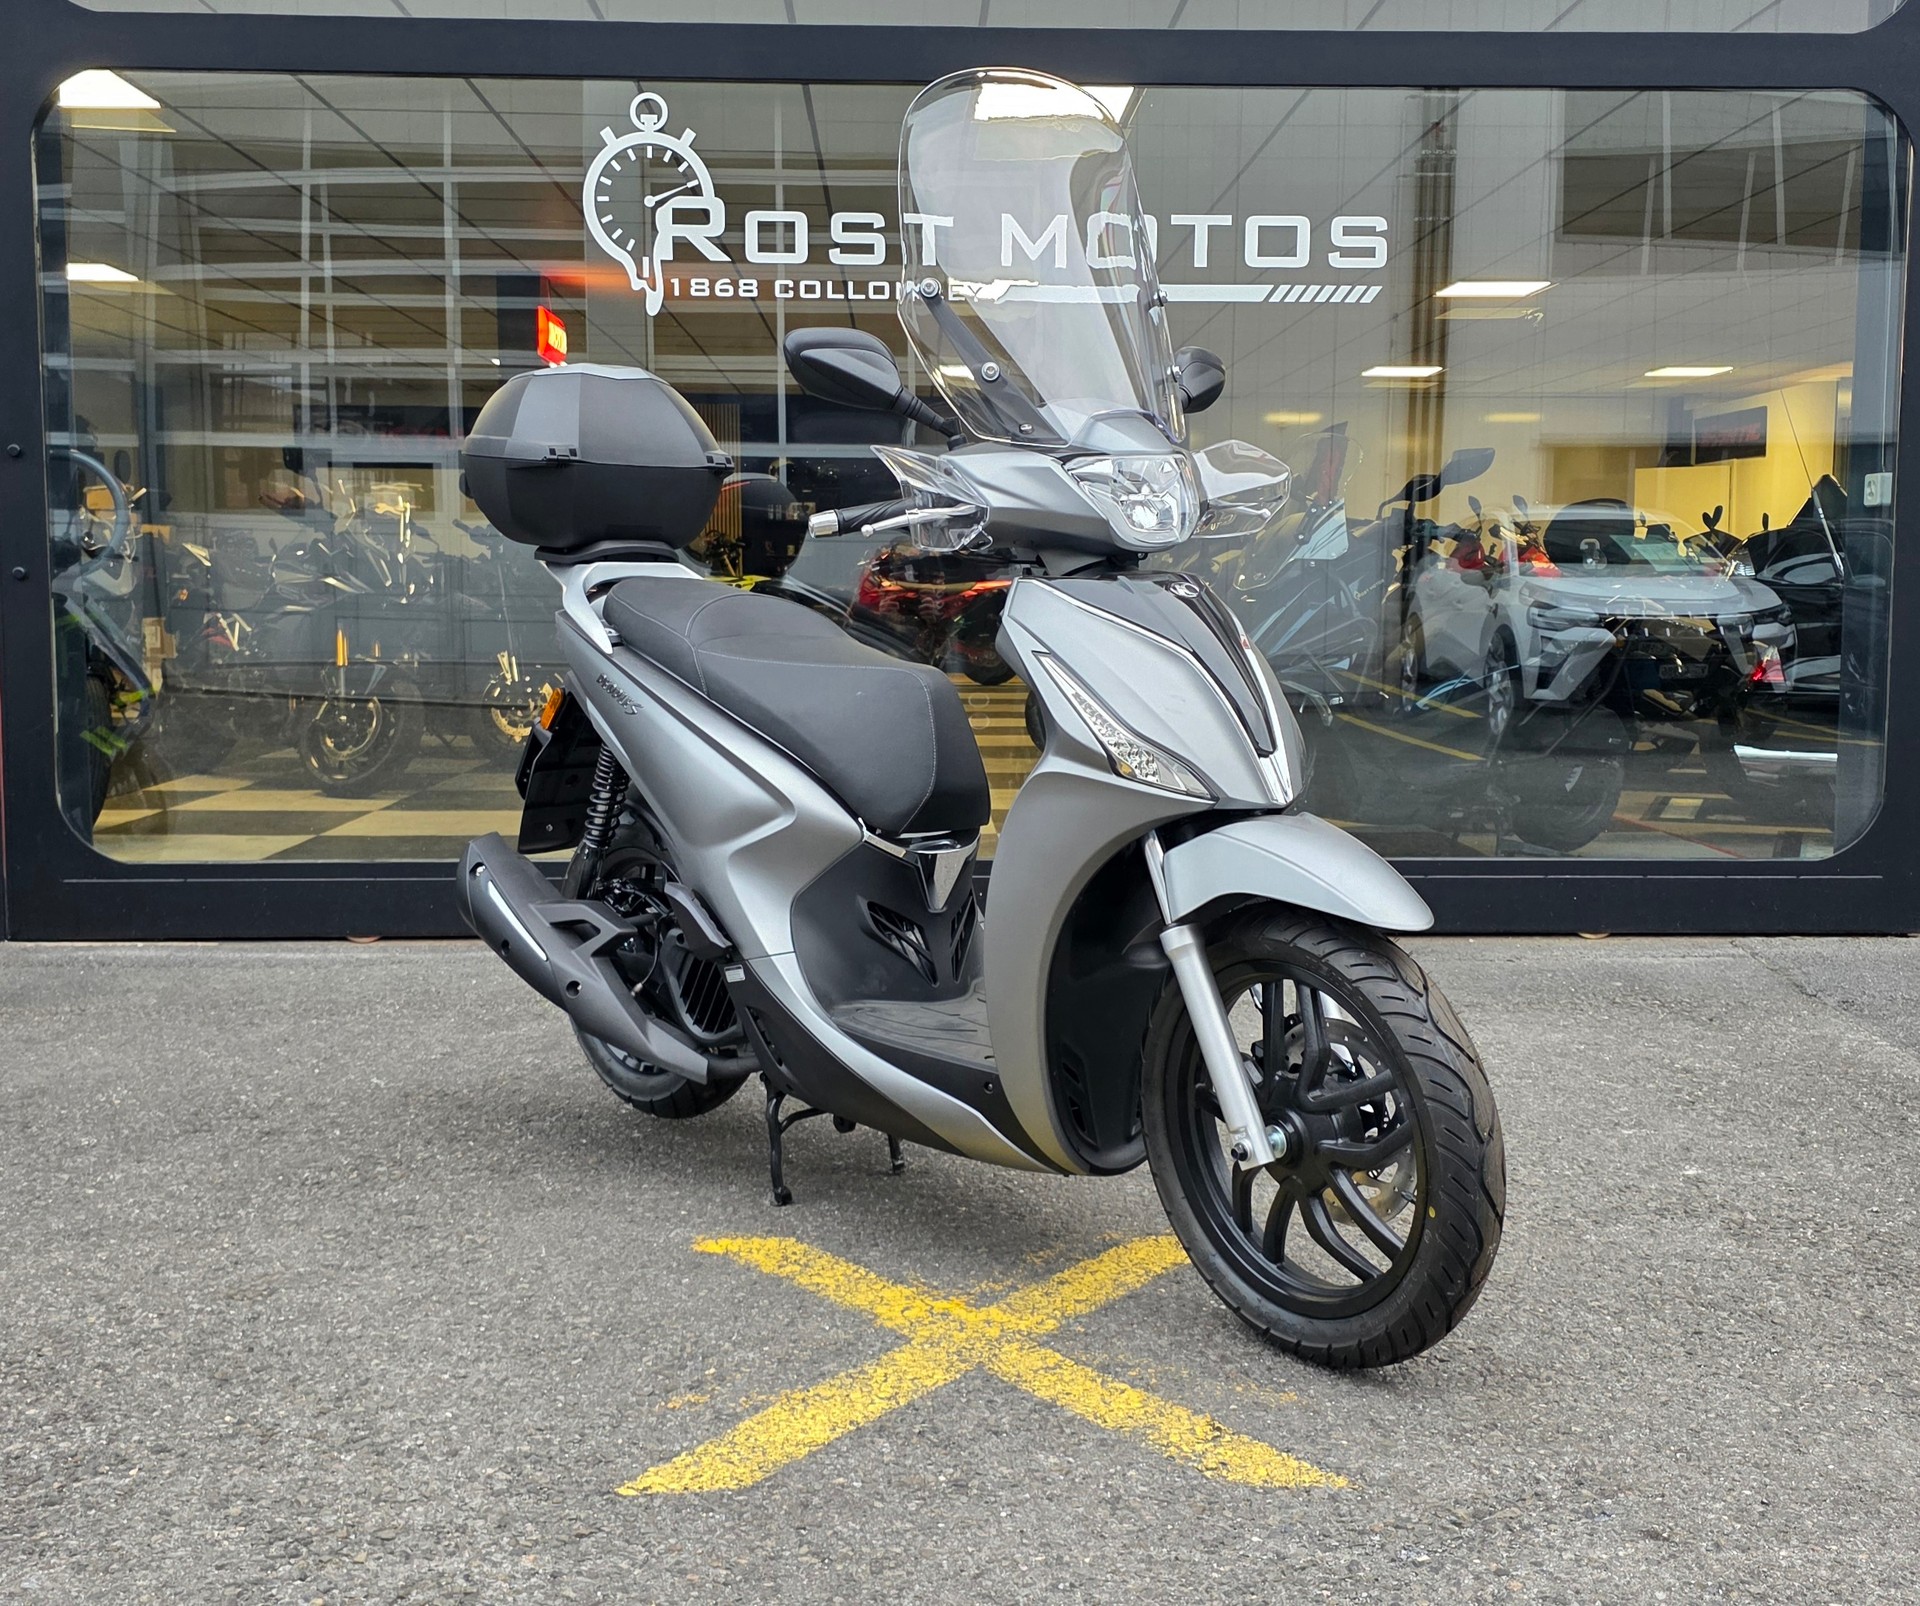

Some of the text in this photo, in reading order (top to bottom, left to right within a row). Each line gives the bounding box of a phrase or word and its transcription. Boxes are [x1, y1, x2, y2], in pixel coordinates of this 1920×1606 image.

[655, 196, 1388, 269] ROST MOTOS
[670, 278, 981, 302] 1868 COLLOMEY
